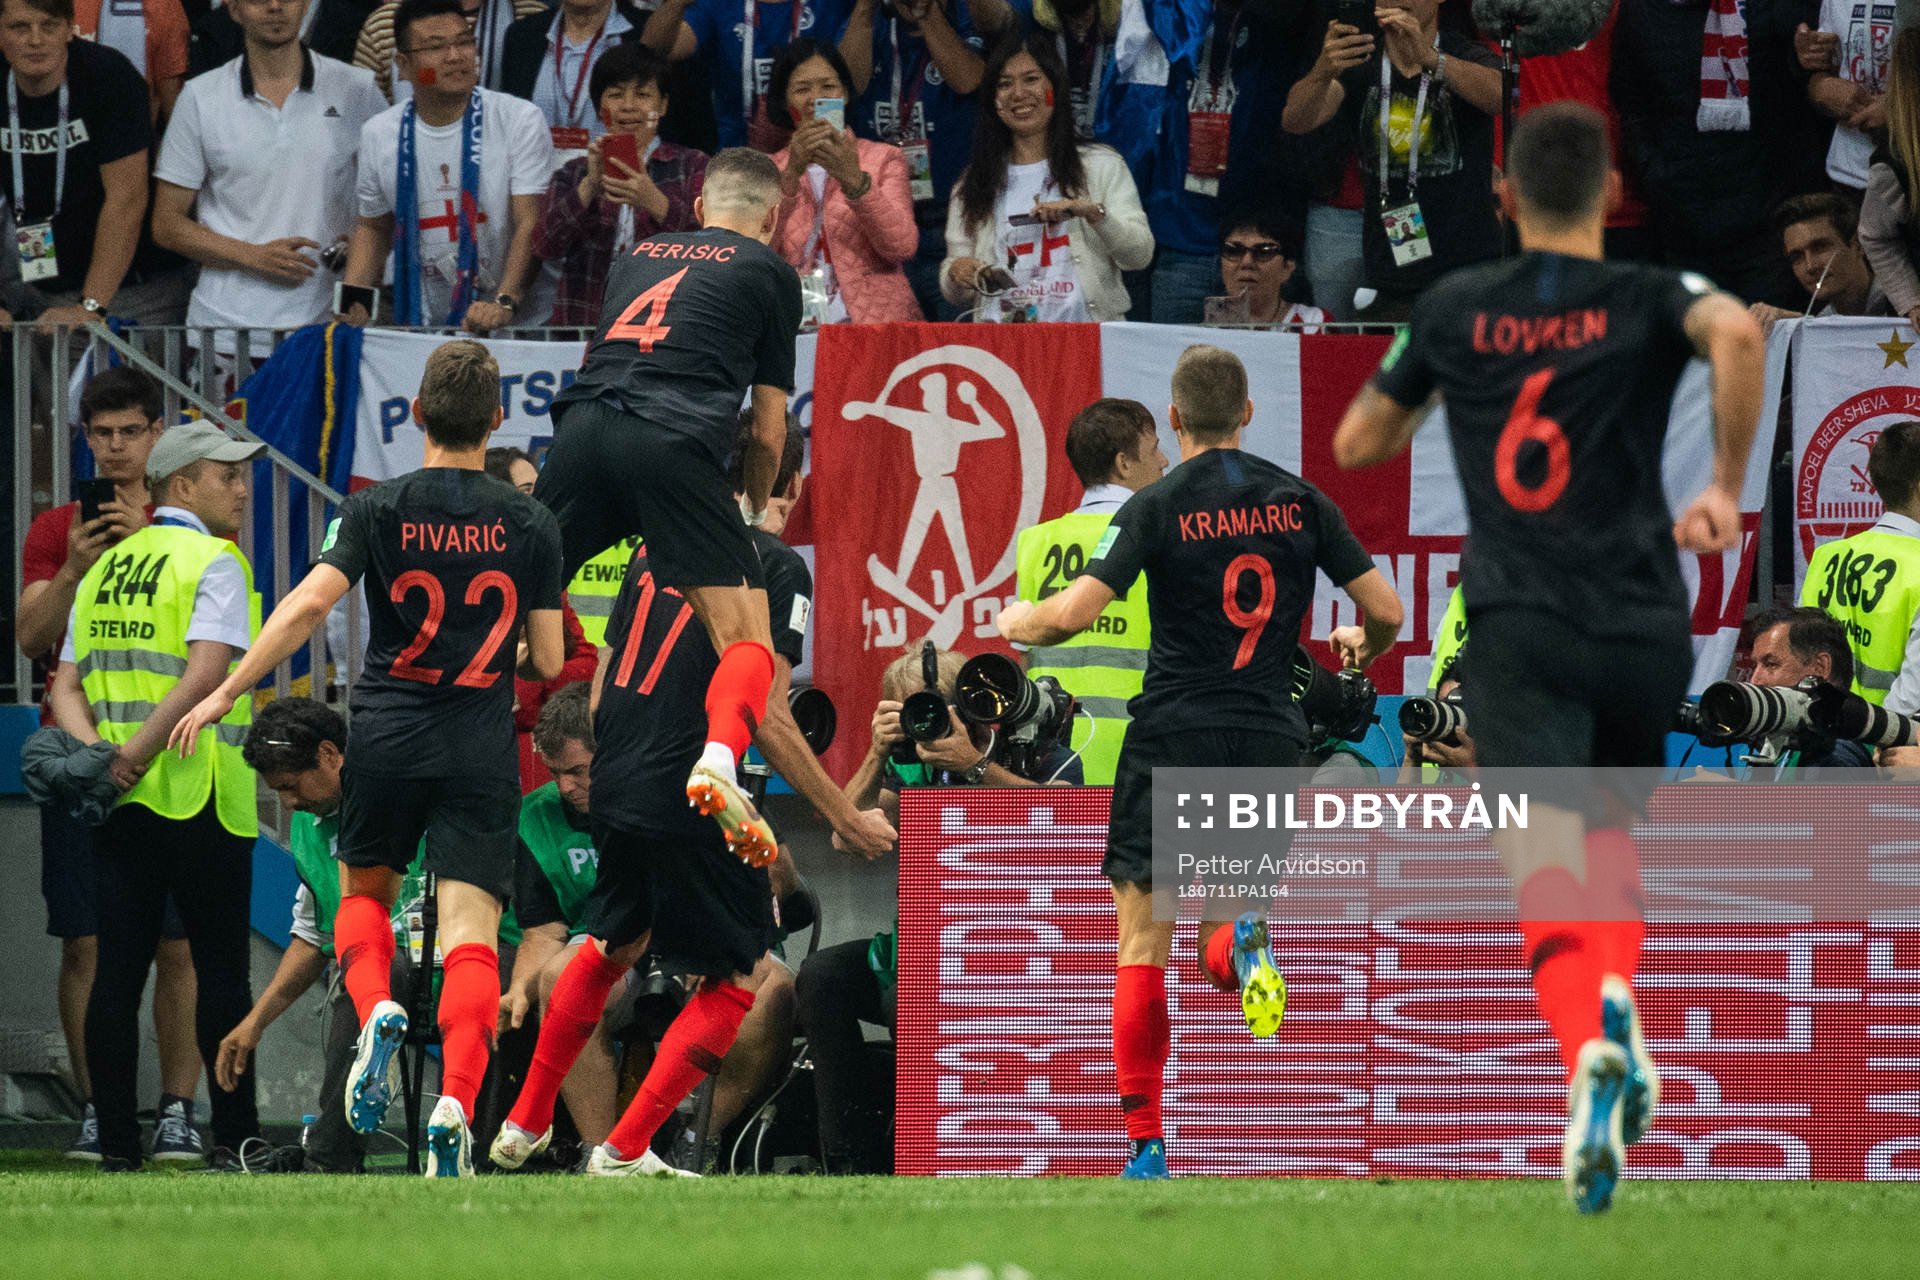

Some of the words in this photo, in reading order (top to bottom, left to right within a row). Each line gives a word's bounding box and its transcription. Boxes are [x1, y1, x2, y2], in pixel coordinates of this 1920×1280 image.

[605, 264, 690, 353] 4
[1495, 367, 1571, 513] 6
[1801, 450, 1824, 512] HAPOEL
[1816, 395, 1890, 450] BEER-SHEVA
[402, 517, 507, 553] PIVARIĆ
[388, 569, 518, 688] 22
[614, 571, 695, 696] 17
[1223, 553, 1276, 670] 9
